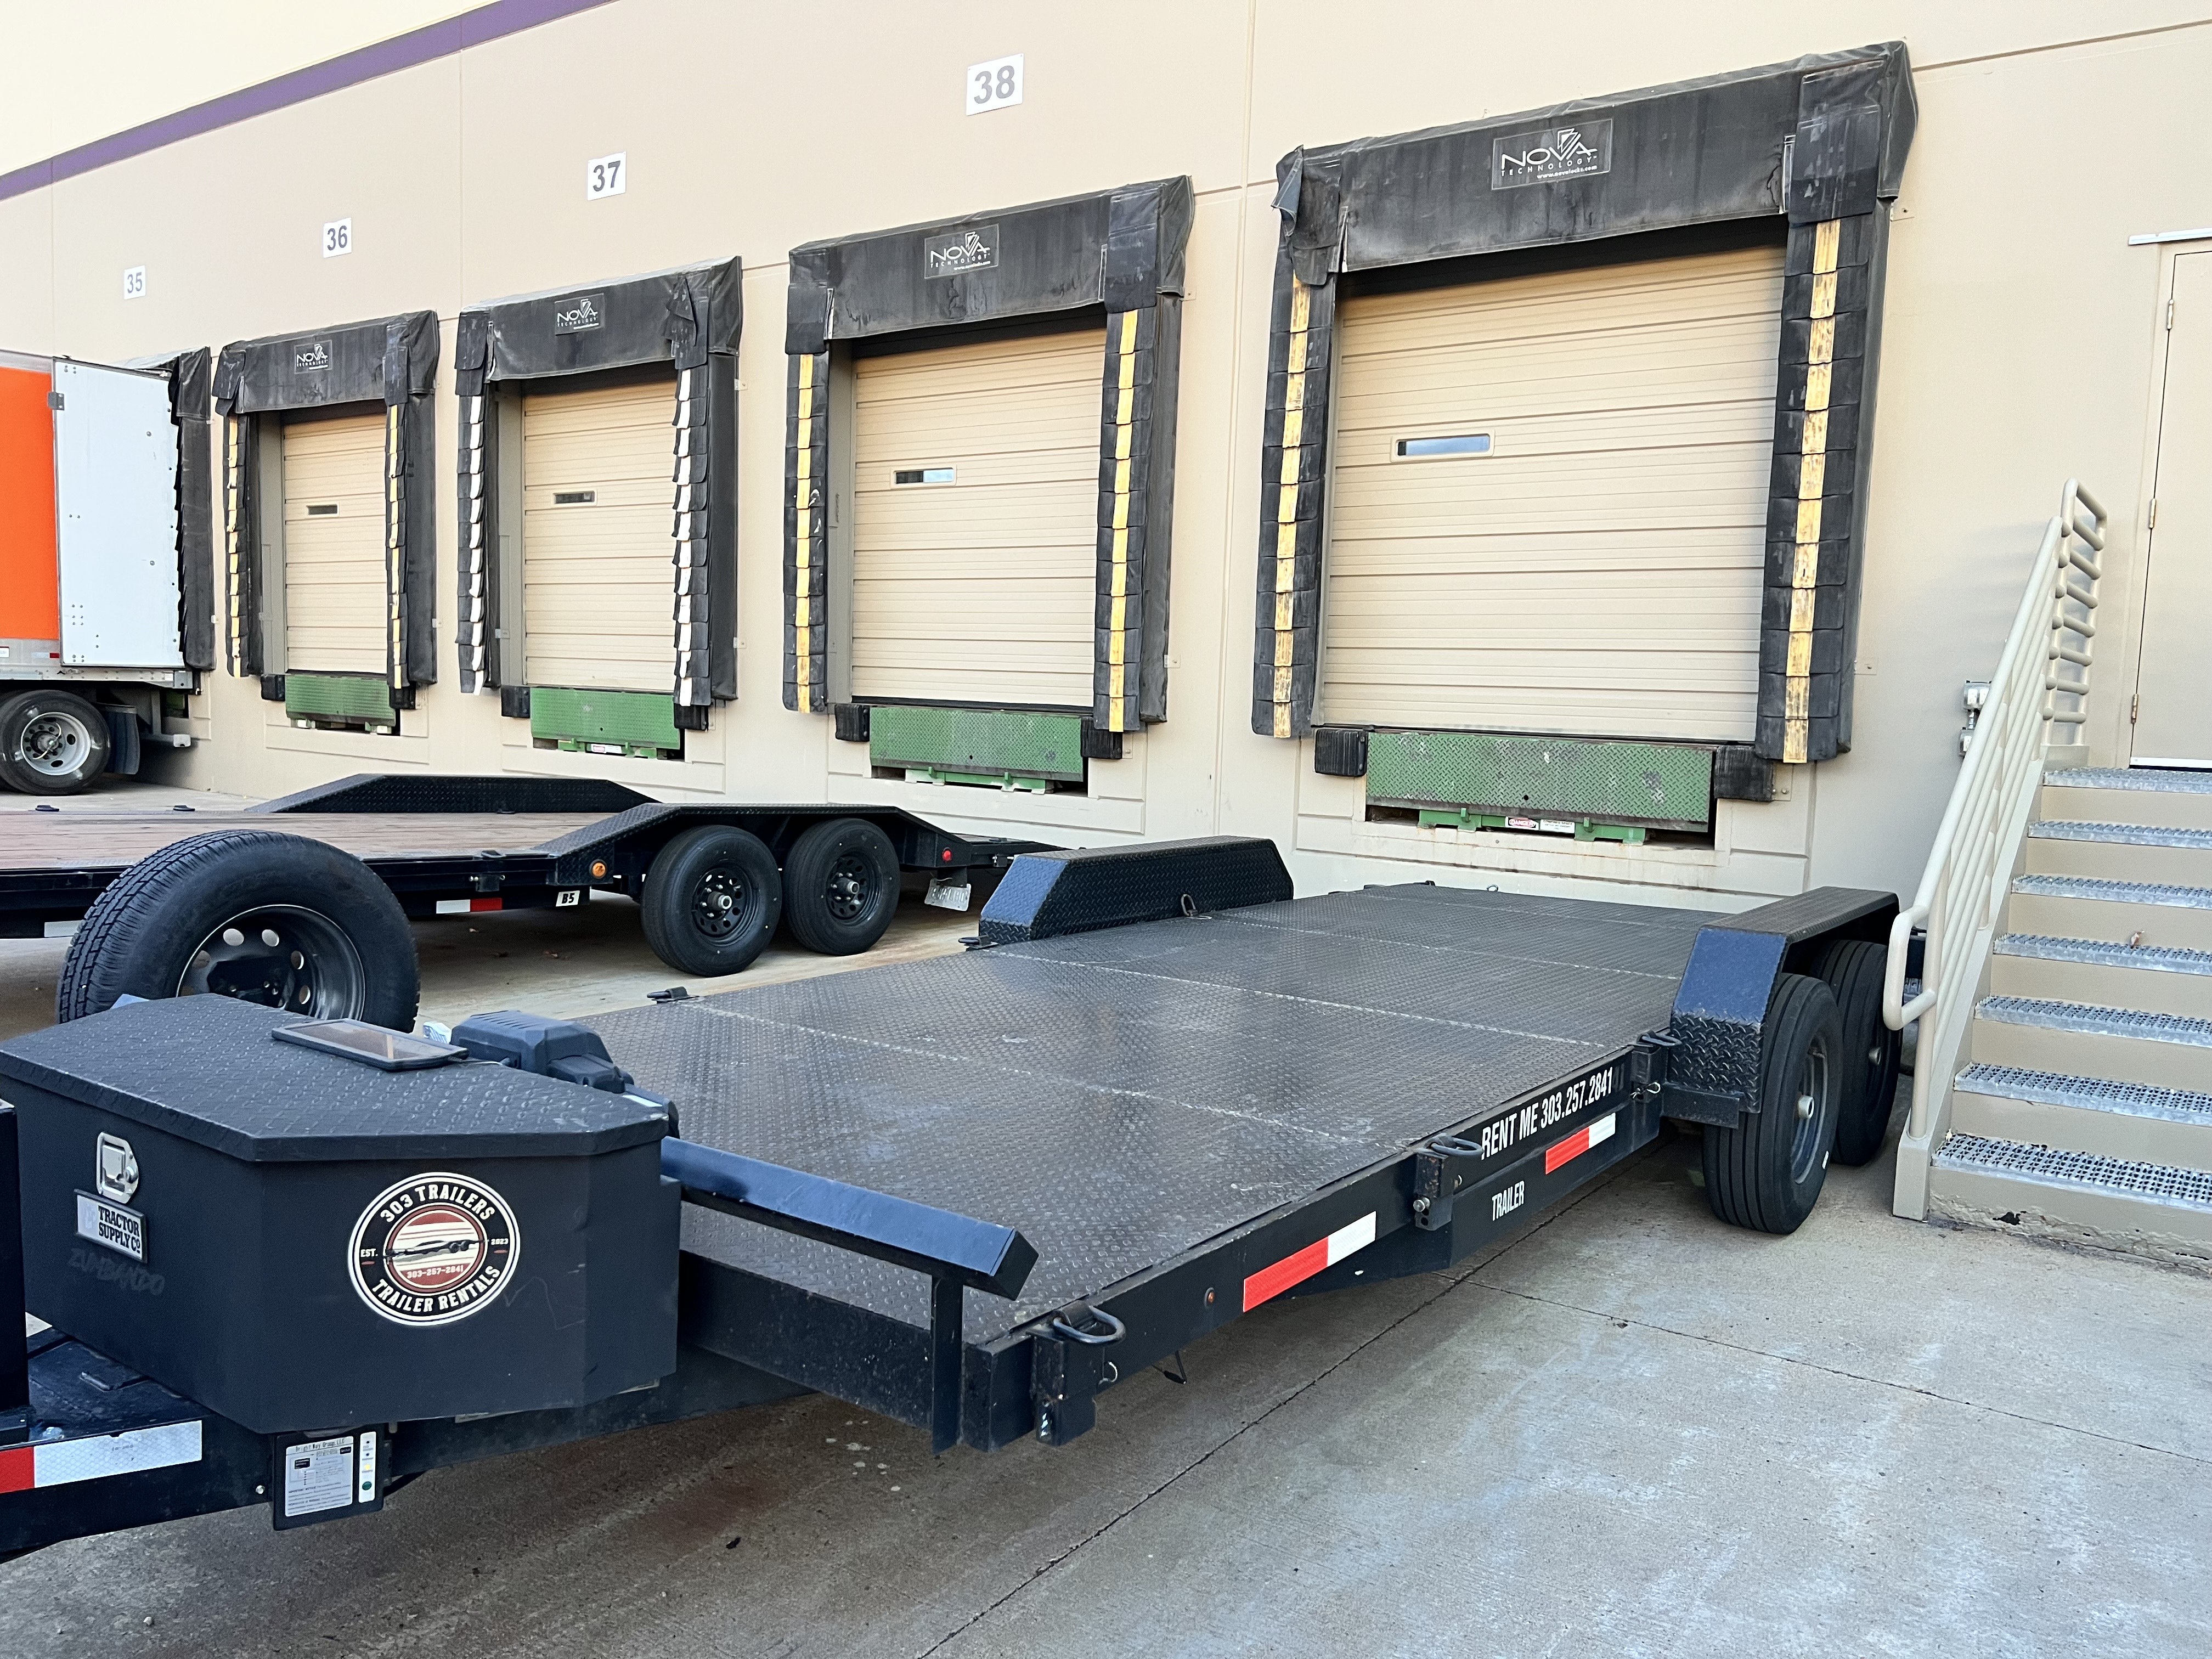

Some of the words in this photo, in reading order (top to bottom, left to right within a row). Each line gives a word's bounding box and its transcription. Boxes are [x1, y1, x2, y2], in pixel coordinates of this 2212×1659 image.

[974, 65, 1015, 104] 38
[1502, 132, 1598, 170] NOVA
[593, 160, 620, 191] 37
[1501, 157, 1593, 176] TECHNOLOGY
[327, 225, 347, 251] 36
[931, 234, 990, 263] NOVA
[127, 272, 142, 294] 35
[557, 301, 598, 323] NOVA
[297, 345, 328, 363] NOVA
[561, 893, 575, 904] B5
[1481, 1113, 1517, 1160] RENT
[1519, 1102, 1538, 1140] ME
[1541, 1067, 1613, 1128] 303.257.2841
[380, 1194, 413, 1222] 303
[415, 1184, 495, 1220] TRAILERS
[1492, 1181, 1525, 1221] TRAILER
[98, 1205, 140, 1237] TRACTOR
[98, 1222, 131, 1249] SUPPLY
[360, 1249, 378, 1257] EST.
[407, 1265, 464, 1278] 303-257-2841
[372, 1279, 433, 1312] TRAILER
[439, 1265, 500, 1310] RENTALS
